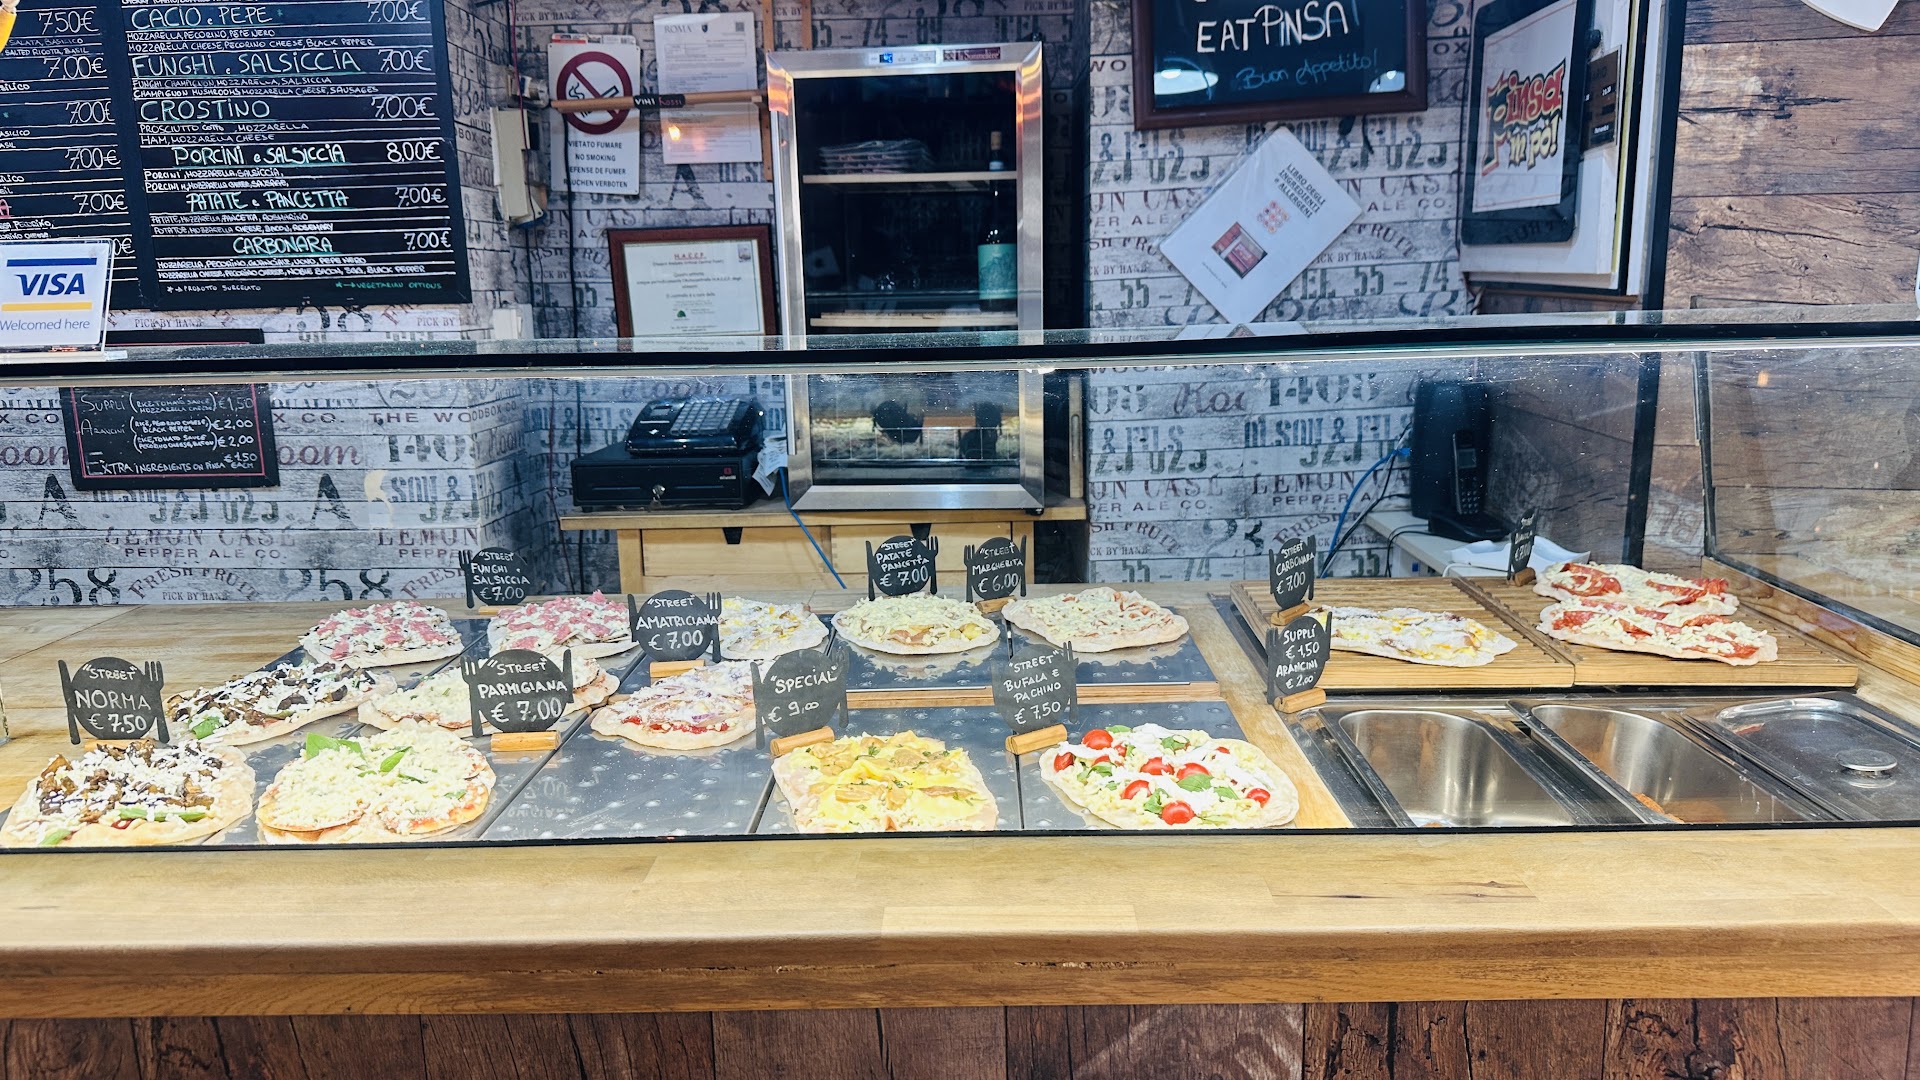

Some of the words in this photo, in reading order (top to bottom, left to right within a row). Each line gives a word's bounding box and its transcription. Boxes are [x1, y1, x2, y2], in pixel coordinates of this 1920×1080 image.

[218, 6, 273, 25] PEPE
[140, 98, 270, 122] CROSTINO
[586, 154, 616, 162] SMOKING
[595, 180, 628, 188] VERBOTEN
[1279, 169, 1321, 213] INGREDIENTI
[1278, 182, 1313, 219] ALLERGENI
[232, 236, 333, 254] CARBONARA
[15, 273, 85, 296] VISA
[0, 319, 61, 331] Welcomed
[64, 319, 91, 329] here
[125, 548, 199, 558] PEPPER
[209, 548, 244, 558] ALE
[875, 548, 913, 564] PATATE
[471, 563, 508, 574] FUNGHI
[473, 575, 531, 585] SALSICCIA
[1275, 659, 1318, 677] ARANCINI
[478, 680, 568, 699] PARMIGIANA
[1003, 672, 1047, 692] BUFALA
[74, 689, 151, 711] NORMA
[1013, 681, 1061, 703] PACHINO
